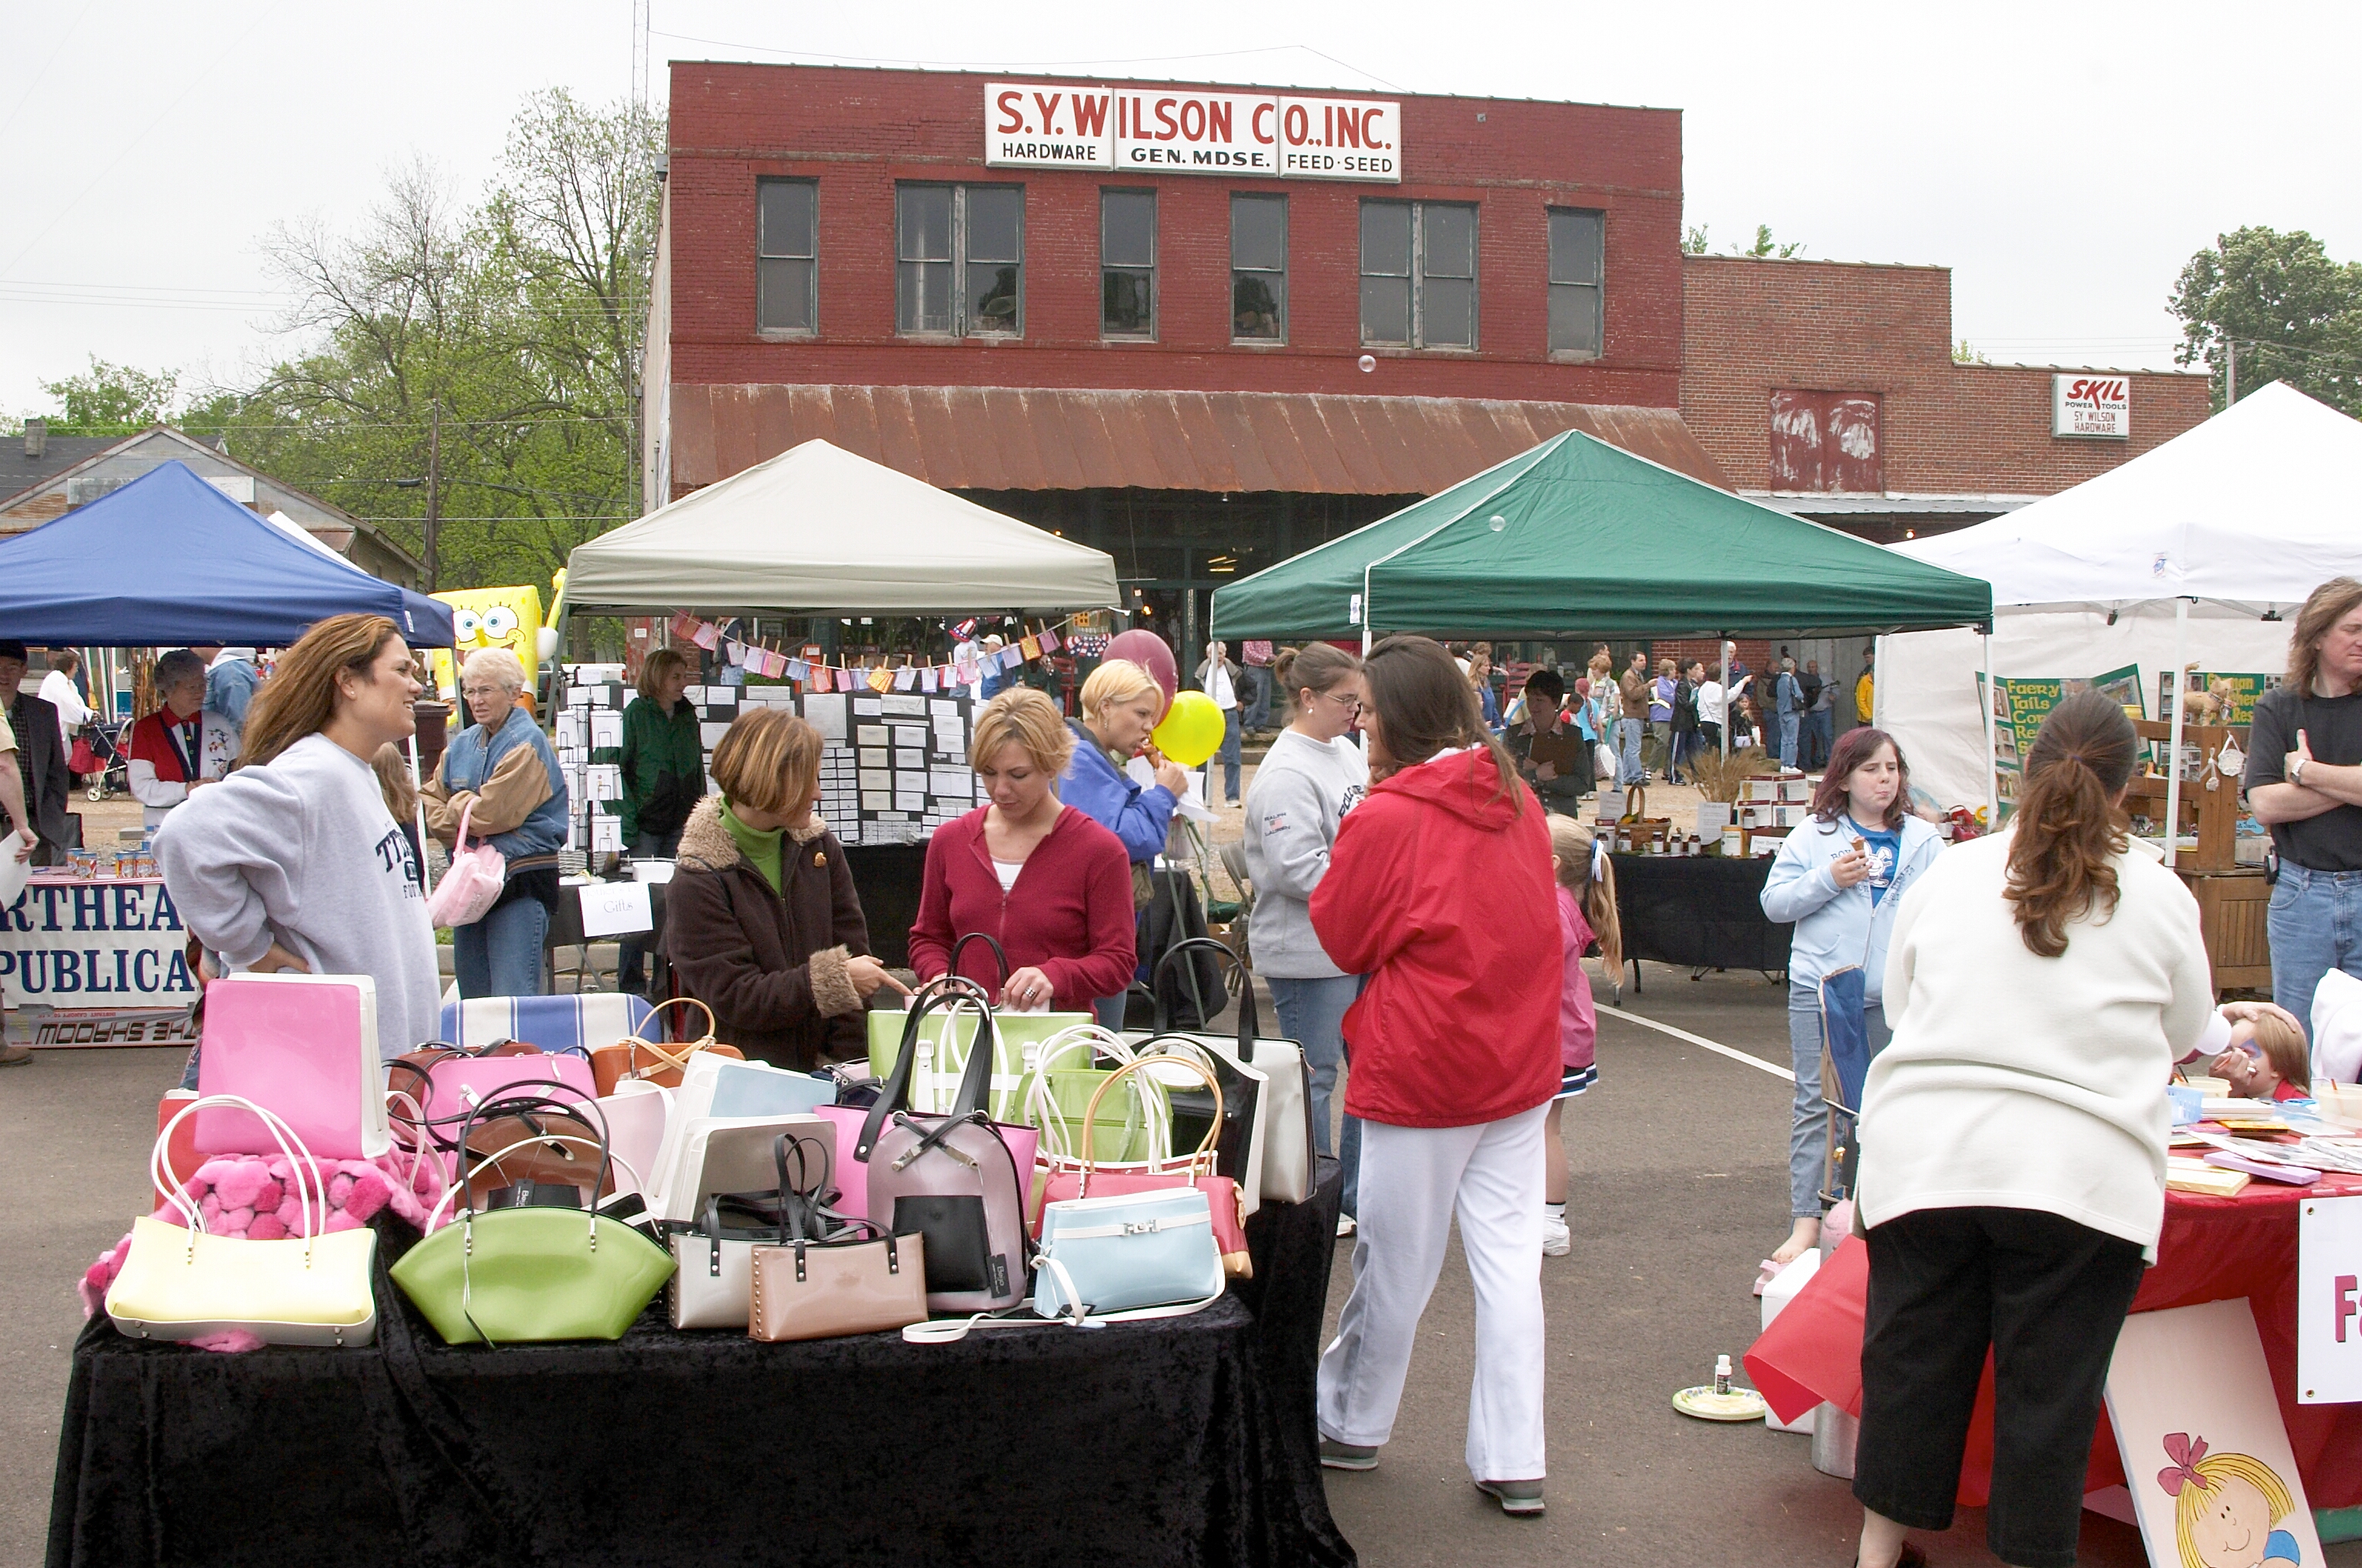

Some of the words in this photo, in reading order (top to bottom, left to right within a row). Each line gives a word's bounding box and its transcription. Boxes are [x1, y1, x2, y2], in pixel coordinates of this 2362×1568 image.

[1003, 142, 1096, 161] HARDWARE
[1131, 147, 1186, 164] GEN.
[1193, 150, 1270, 168] MDSE.
[2067, 379, 2125, 410] SKIL
[2074, 411, 2083, 422] SY
[2087, 412, 2116, 422] WILSON
[2074, 422, 2117, 433] HARDWARE
[2010, 696, 2050, 709] Tails
[603, 899, 634, 913] Gifts
[0, 949, 199, 994] PUBLICA
